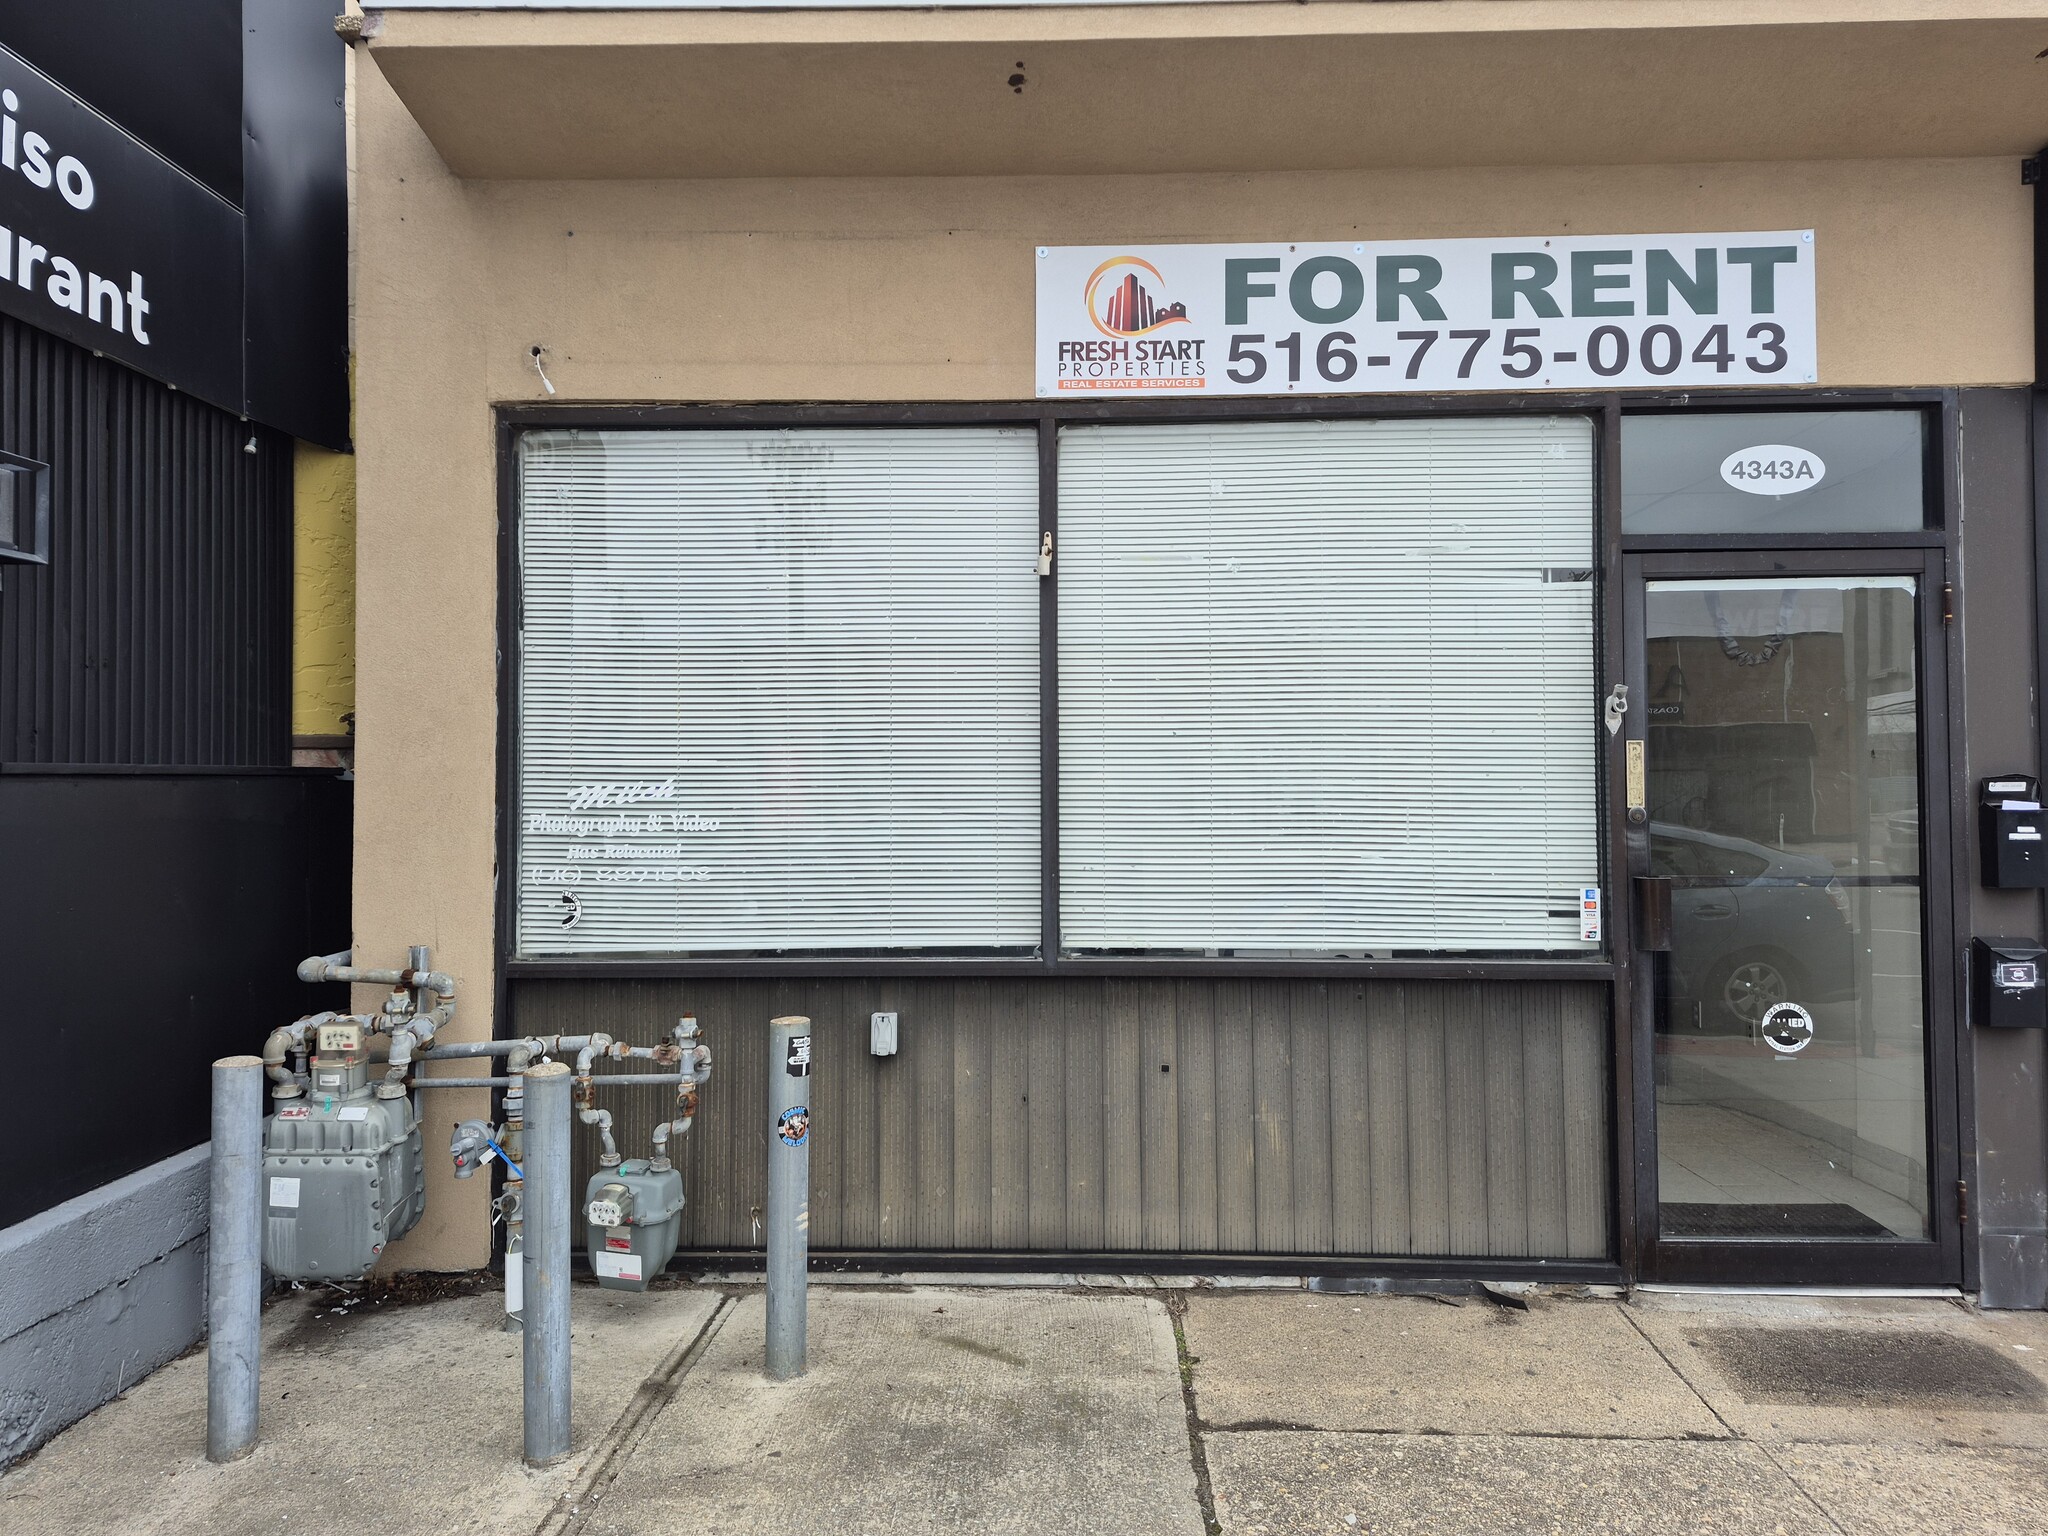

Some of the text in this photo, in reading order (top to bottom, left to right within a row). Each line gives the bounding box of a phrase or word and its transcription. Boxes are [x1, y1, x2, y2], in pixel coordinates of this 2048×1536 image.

[1225, 246, 1798, 325] FOR RENT
[1058, 339, 1205, 361] FRESH START
[1226, 322, 1788, 384] 516-775-0043
[1058, 361, 1206, 377] PROPERTIES
[1063, 379, 1200, 388] REAL ESTATE SERVICES
[1730, 459, 1815, 480] 4343A
[529, 813, 720, 837] Photography & Video
[567, 845, 600, 859] Has
[1766, 1003, 1809, 1019] WARNING
